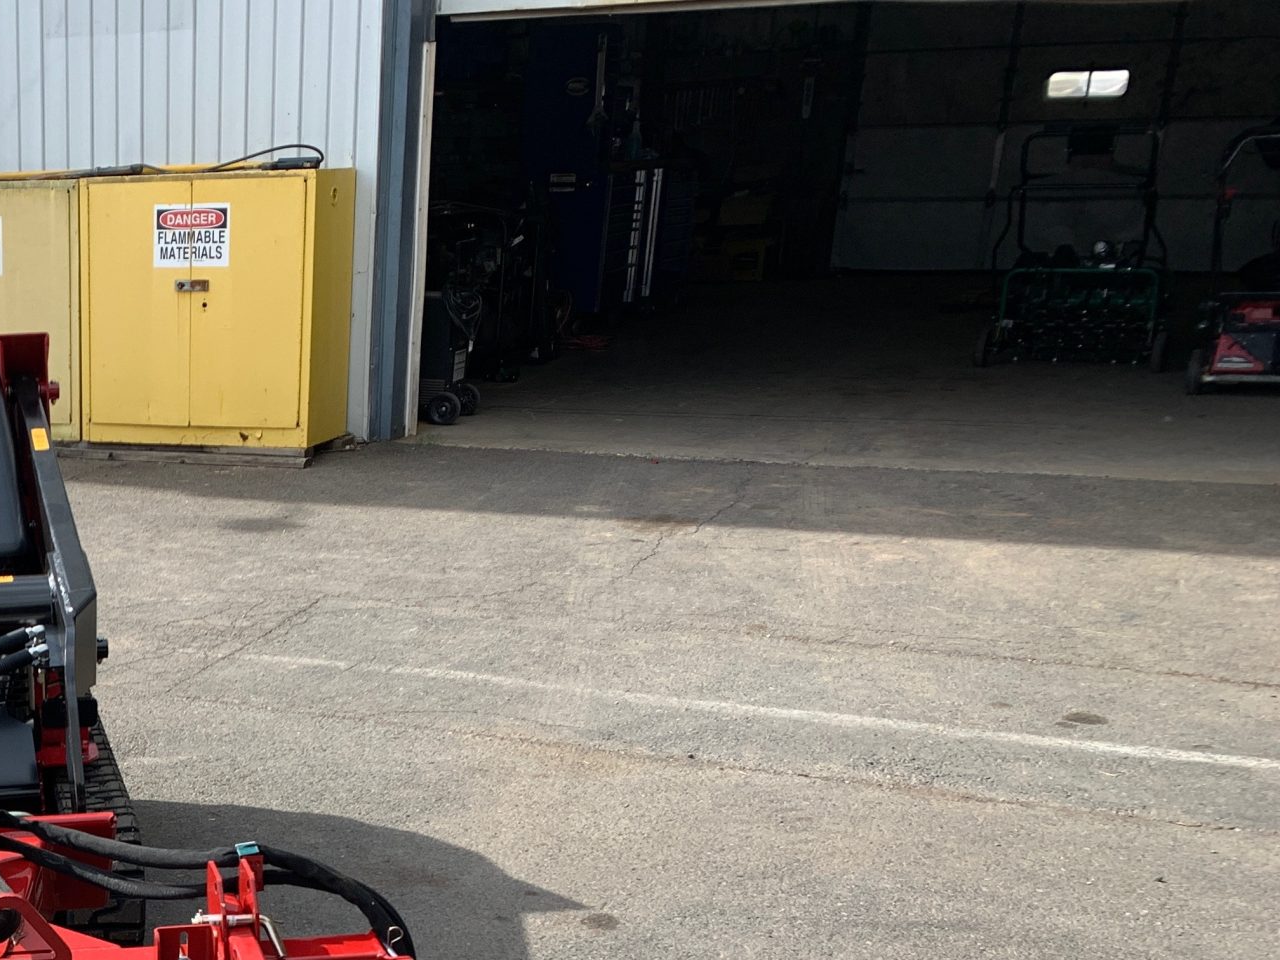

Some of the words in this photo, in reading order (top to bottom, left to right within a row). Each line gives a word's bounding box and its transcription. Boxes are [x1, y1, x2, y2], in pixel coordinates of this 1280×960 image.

[166, 212, 217, 225] DANGER
[157, 230, 226, 245] FLAMMABLE
[160, 245, 223, 260] MATERIALS
